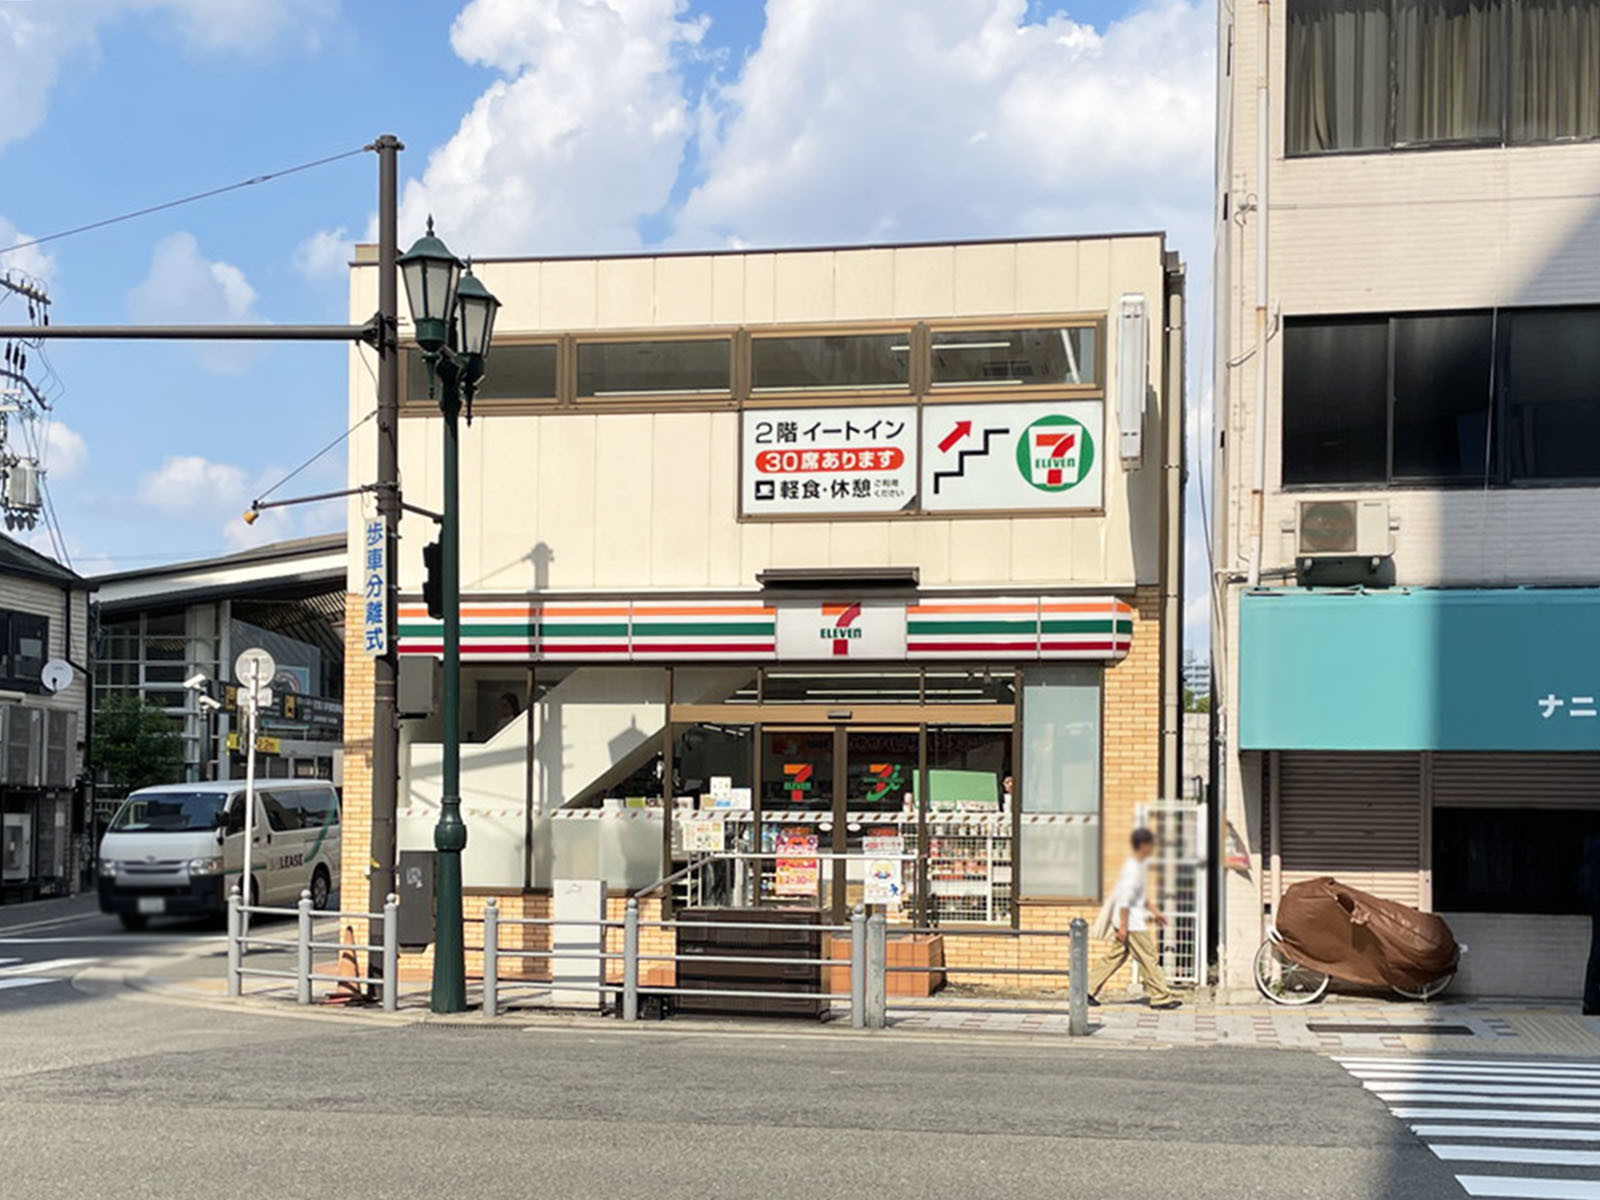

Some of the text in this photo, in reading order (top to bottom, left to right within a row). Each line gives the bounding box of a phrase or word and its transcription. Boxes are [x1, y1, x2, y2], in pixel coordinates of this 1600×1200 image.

[755, 420, 905, 443] 2階イートイン
[765, 450, 895, 472] 30席あります
[366, 521, 384, 651] 歩車分離式
[1538, 694, 1597, 719] ナニ
[279, 853, 304, 869] LEASE
